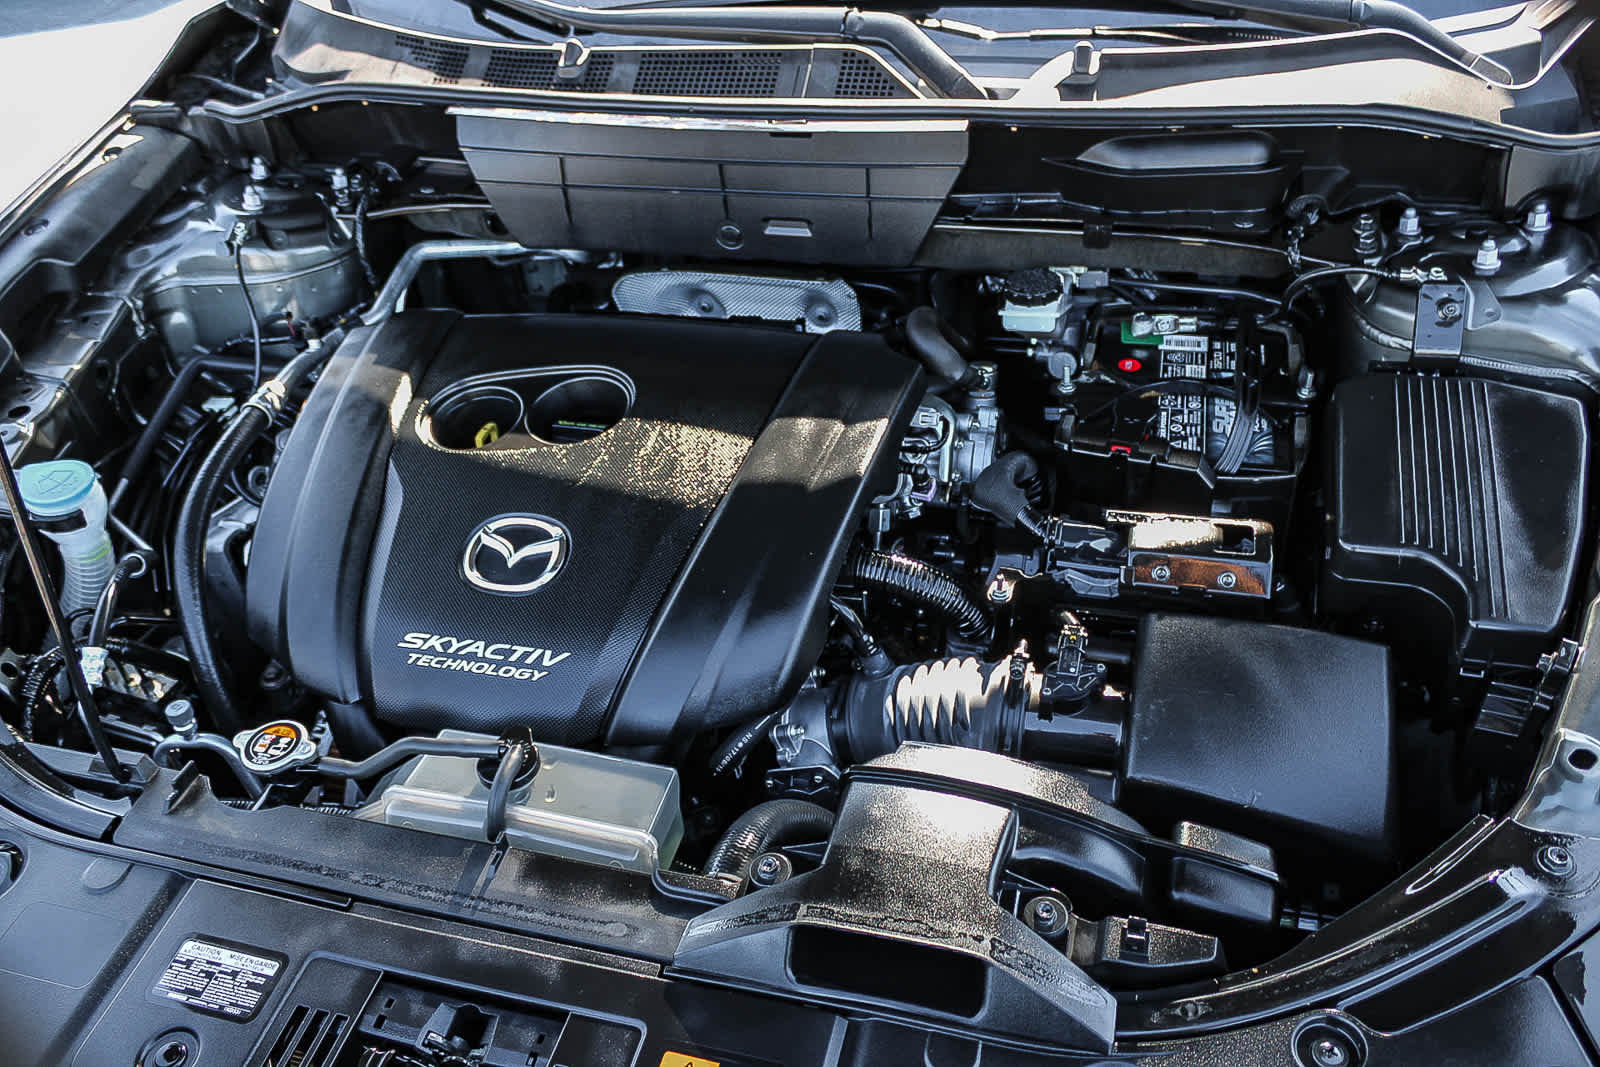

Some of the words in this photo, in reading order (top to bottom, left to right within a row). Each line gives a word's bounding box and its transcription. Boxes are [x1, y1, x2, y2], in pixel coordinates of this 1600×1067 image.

[397, 631, 572, 667] SKYACTIV
[407, 652, 549, 682] TECHNOLOGY
[191, 944, 221, 956] CAUTION
